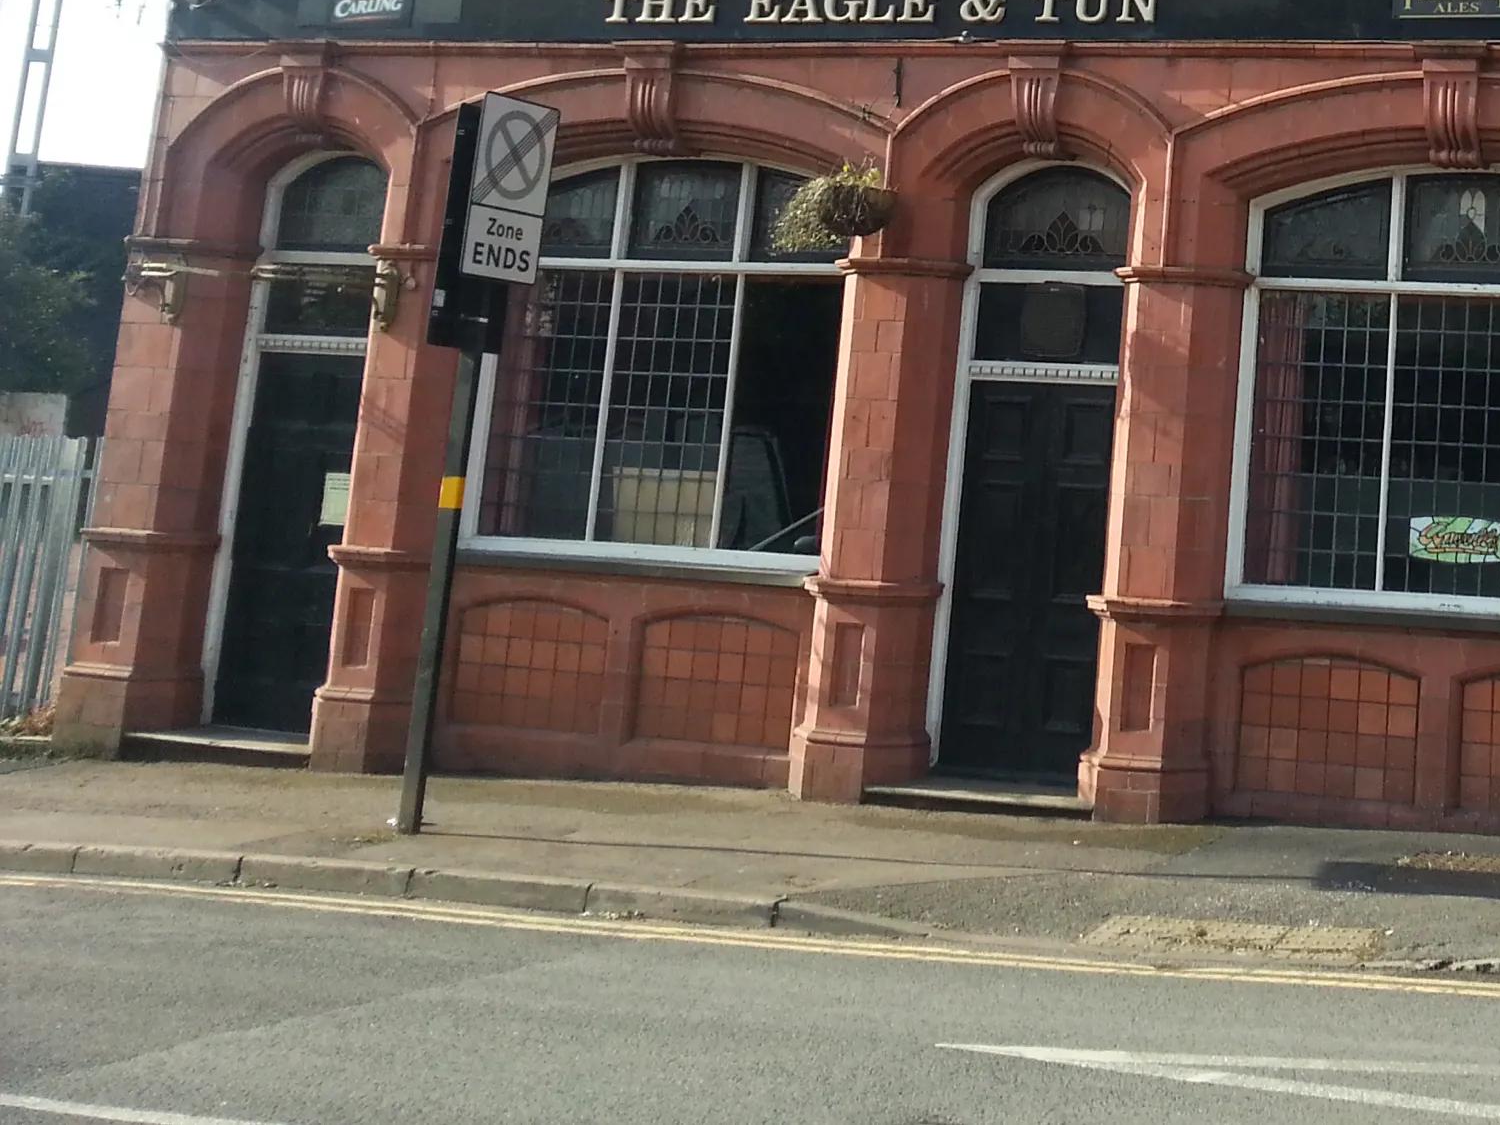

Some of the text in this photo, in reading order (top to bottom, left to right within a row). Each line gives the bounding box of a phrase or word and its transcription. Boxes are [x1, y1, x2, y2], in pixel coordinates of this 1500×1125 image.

[1433, 2, 1480, 13] ALES
[486, 217, 524, 242] Zone
[472, 242, 531, 272] ENDS
